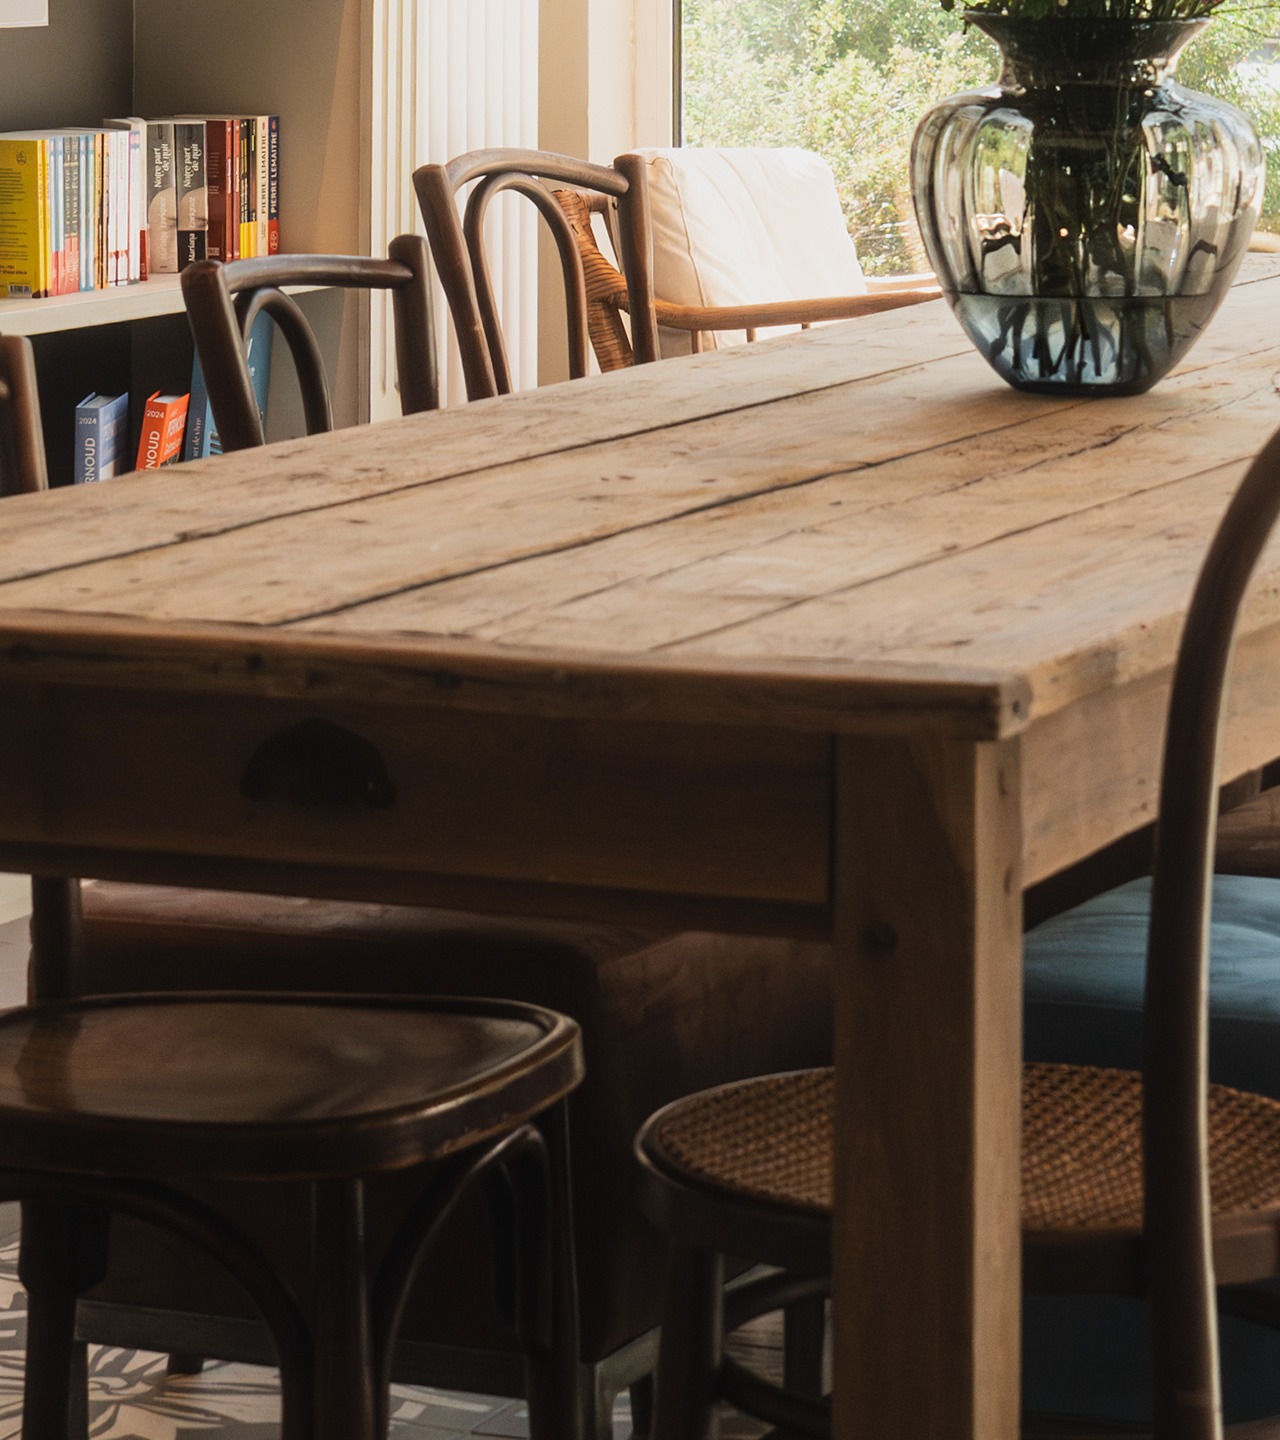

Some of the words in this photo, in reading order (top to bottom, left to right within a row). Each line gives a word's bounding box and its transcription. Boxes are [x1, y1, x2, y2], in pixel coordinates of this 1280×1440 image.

[154, 148, 164, 166] part
[162, 143, 171, 162] nuit
[184, 148, 194, 166] part
[192, 143, 201, 162] nuit
[154, 167, 164, 188] Notre
[184, 167, 194, 188] Notre
[188, 233, 197, 262] Mariana
[79, 417, 97, 425] 2024
[146, 409, 165, 419] 2024
[145, 430, 161, 470] NOUD
[85, 437, 96, 484] RNOUD
